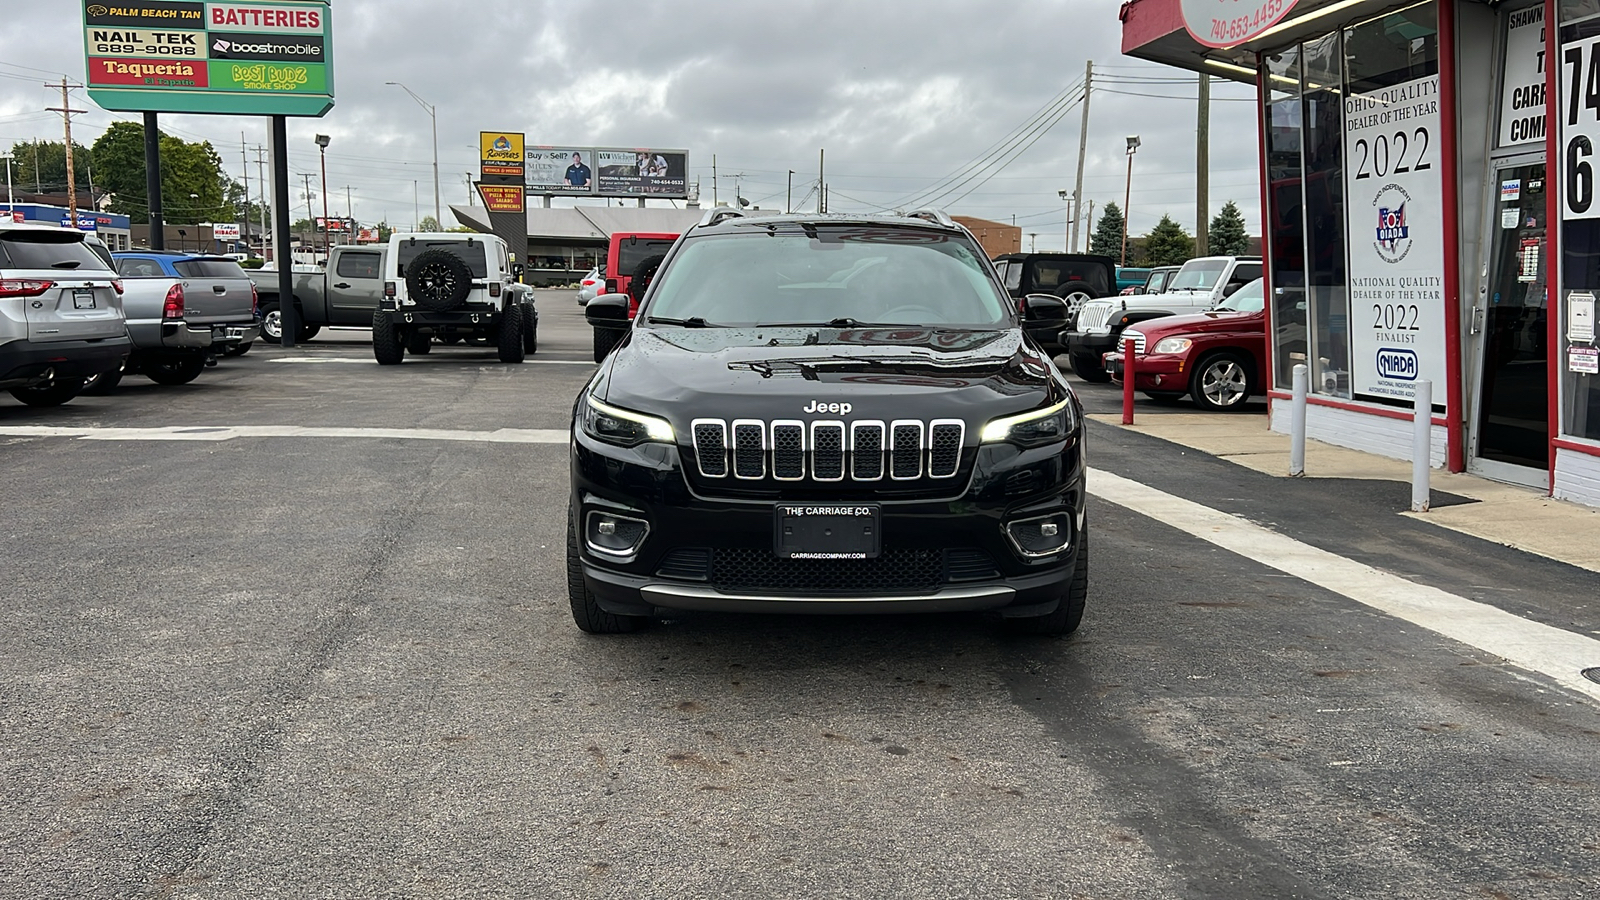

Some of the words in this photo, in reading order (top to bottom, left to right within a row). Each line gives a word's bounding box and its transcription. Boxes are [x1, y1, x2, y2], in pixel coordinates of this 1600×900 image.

[109, 8, 138, 17] PALM
[141, 9, 177, 18] BEACH
[180, 11, 201, 19] TAN
[212, 8, 320, 28] BATTERIES
[1210, 0, 1283, 40] 740-653-4455
[1510, 7, 1543, 29] SHAWN
[93, 31, 143, 43] NAIL
[152, 33, 197, 45] TEK
[97, 44, 196, 55] 689-9088
[232, 42, 321, 55] boostmobile
[1346, 95, 1376, 114] OHIO
[1381, 79, 1438, 108] QUALITY
[1512, 83, 1547, 110] CARR
[1348, 114, 1379, 131] DEALER
[1380, 111, 1392, 124] OF
[1393, 106, 1411, 121] THE
[1413, 100, 1437, 117] YEAR
[486, 148, 520, 159] Roosters
[528, 152, 542, 160] Buy
[1355, 127, 1431, 180] 2022
[1380, 228, 1403, 239] OIADA
[1353, 278, 1395, 287] NATIONAL
[1400, 277, 1440, 288] QUALITY
[1353, 290, 1382, 299] DEALER
[1385, 290, 1395, 299] OF
[1399, 291, 1414, 299] THE
[1418, 290, 1440, 299] YEAR
[1373, 304, 1419, 330] 2022
[1376, 333, 1415, 343] FINALIST
[1380, 355, 1414, 374] NIADA
[803, 400, 853, 416] Jeep
[785, 507, 804, 516] THE
[805, 507, 853, 515] CARRIAGE
[854, 507, 871, 516] CO.
